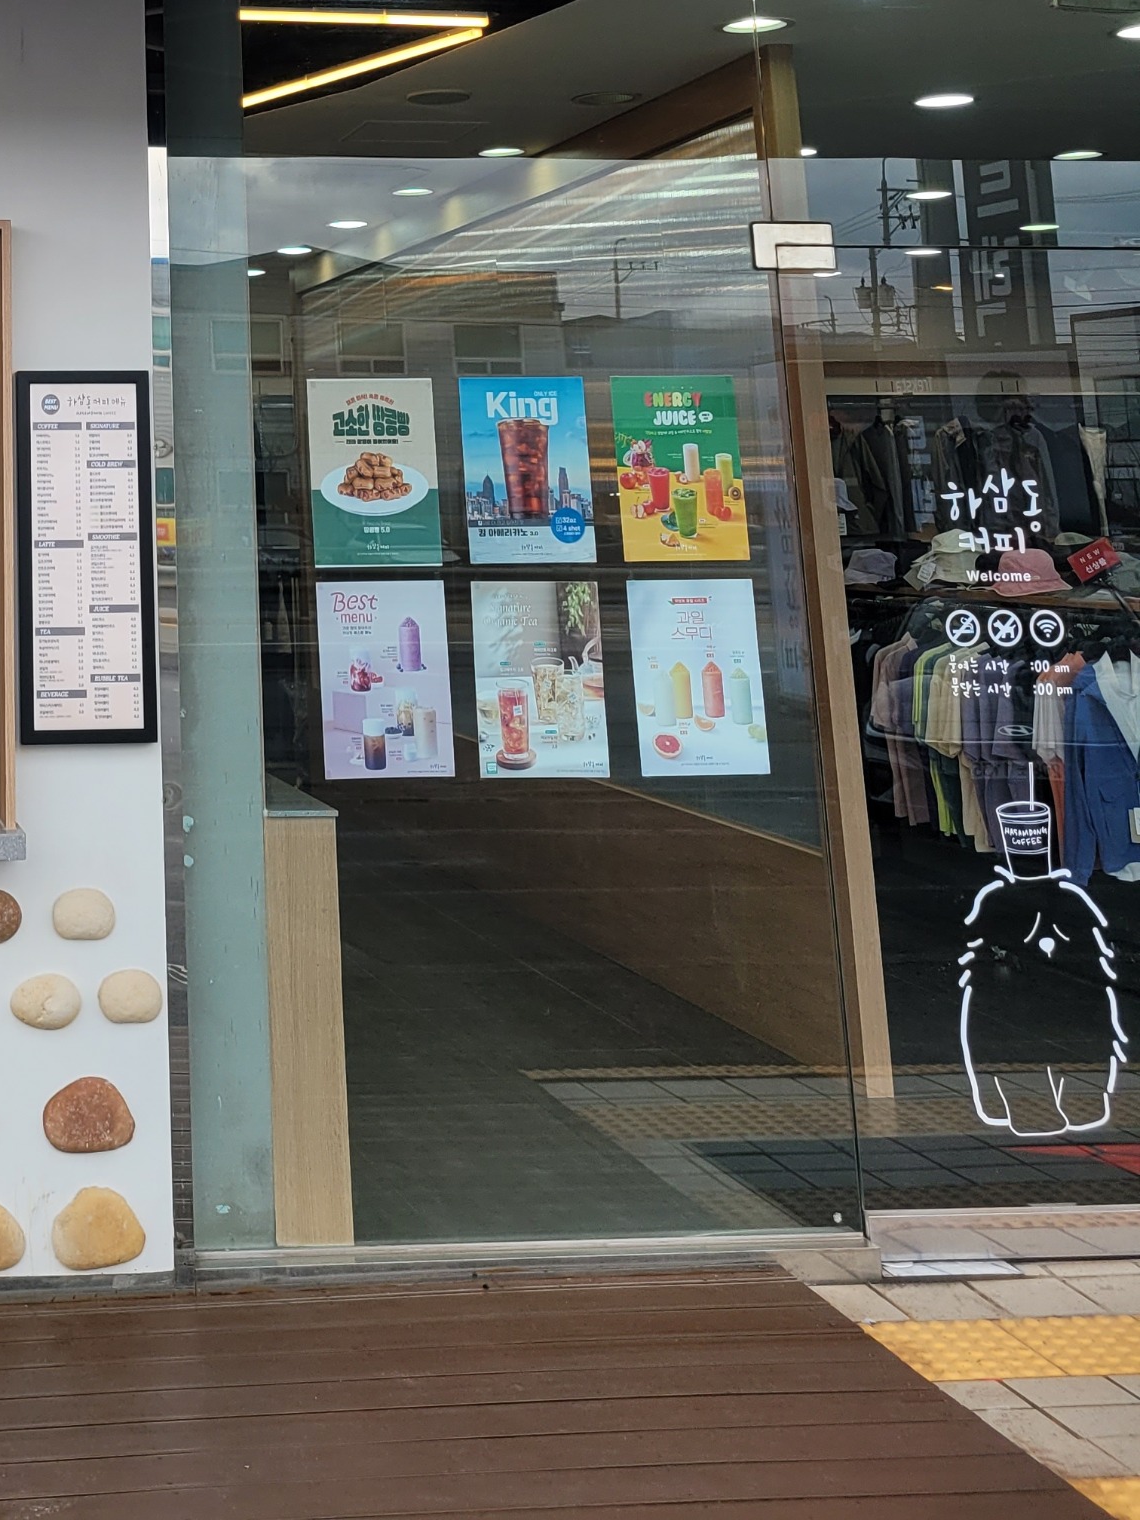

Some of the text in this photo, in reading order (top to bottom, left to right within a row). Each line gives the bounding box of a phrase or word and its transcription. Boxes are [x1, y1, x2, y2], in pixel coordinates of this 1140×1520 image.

[644, 392, 702, 408] ENERGY
[485, 391, 559, 426] King
[332, 404, 370, 437] 고소한
[653, 410, 696, 426] JUICE
[940, 468, 1043, 533] 하삼동
[488, 528, 529, 538] 아메리카노
[958, 526, 1026, 554] 커피
[1079, 548, 1100, 564] NEW
[966, 569, 1031, 582] Welcome
[330, 592, 379, 613] Best
[340, 613, 373, 624] menu
[519, 615, 539, 627] Tea
[675, 610, 705, 625] 과일
[671, 626, 713, 641] 스무디
[984, 659, 1010, 673] 시간
[1054, 664, 1070, 673] am
[987, 684, 1012, 698] 시간
[1056, 685, 1073, 696] pm
[1004, 826, 1048, 836] HASAMDONG
[1011, 836, 1042, 846] COFFEE
